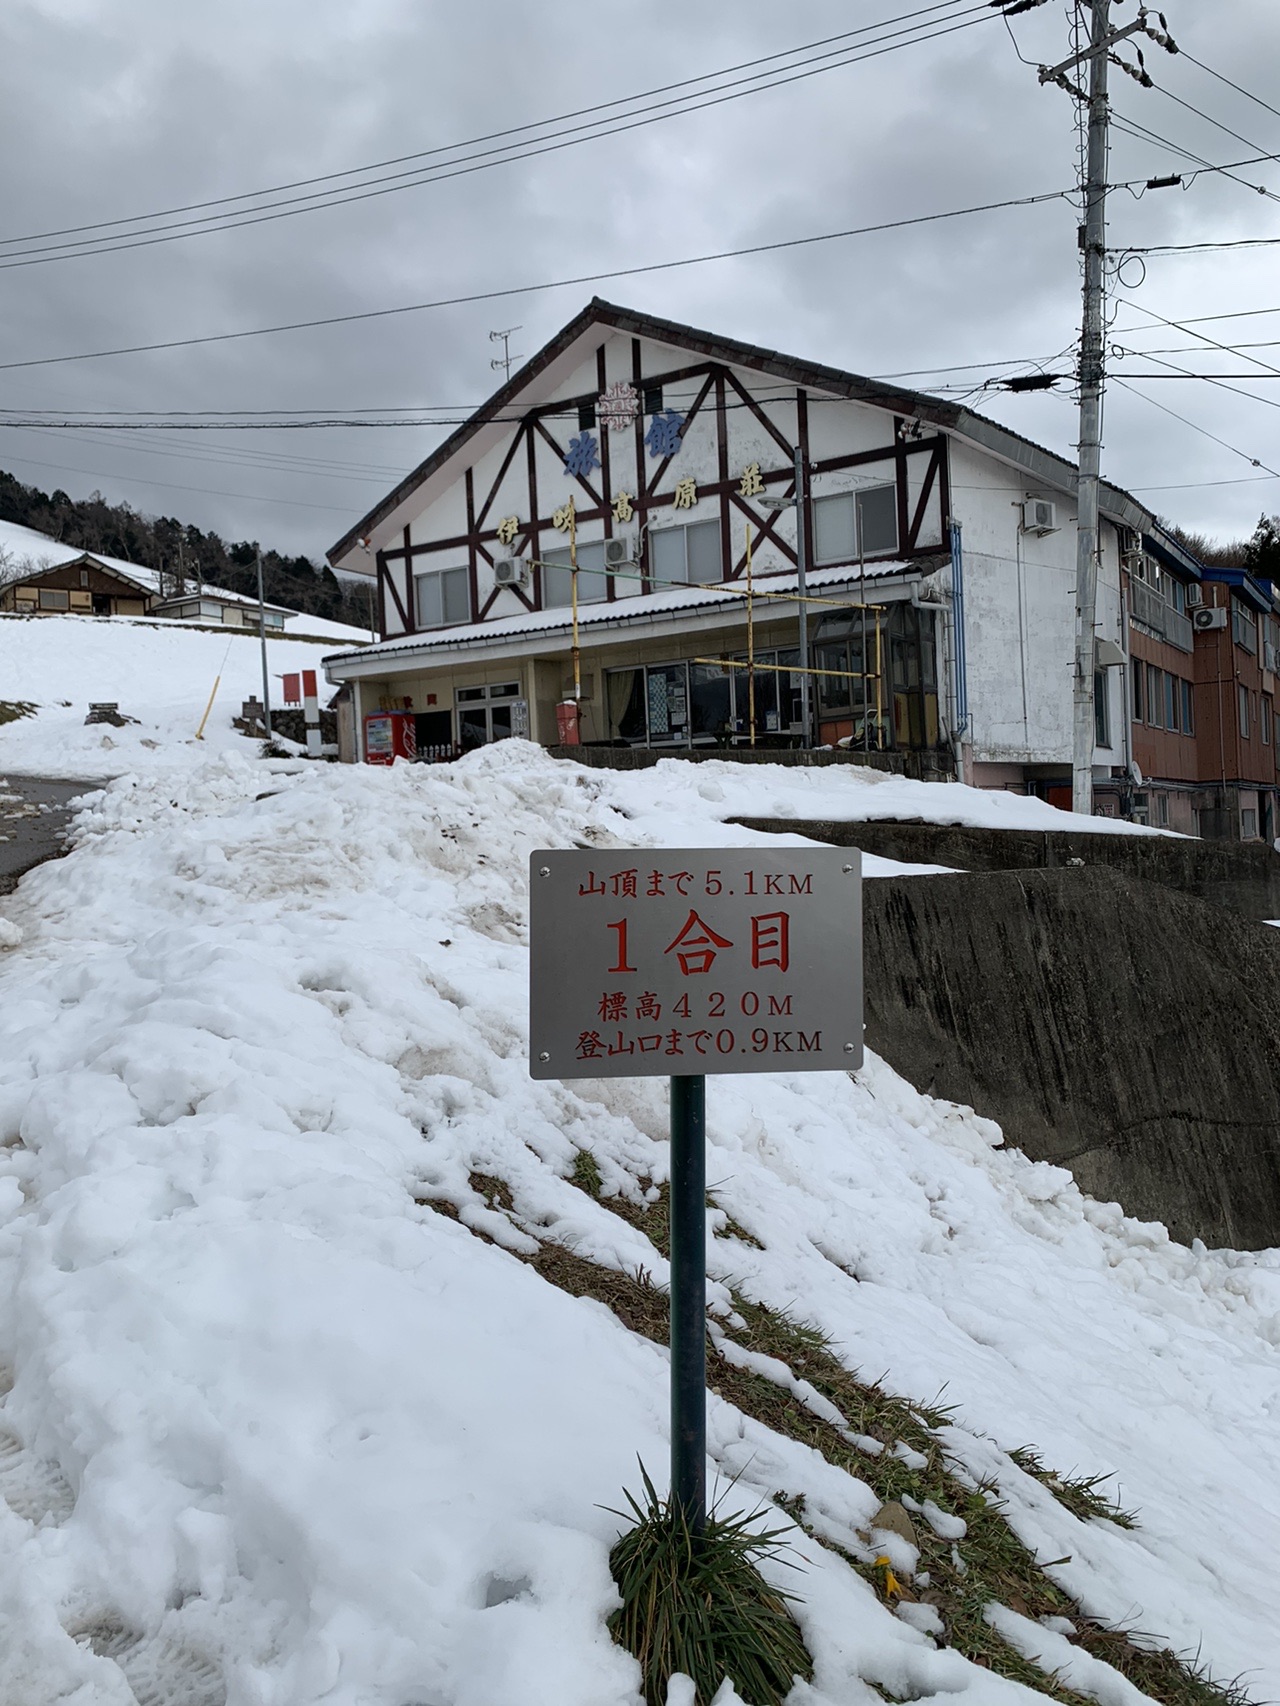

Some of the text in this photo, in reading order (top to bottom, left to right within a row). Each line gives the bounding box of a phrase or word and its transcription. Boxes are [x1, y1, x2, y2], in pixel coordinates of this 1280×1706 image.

[563, 407, 685, 478] 旅館
[606, 908, 790, 977] 1合目
[597, 990, 794, 1023] 標高420M
[575, 1027, 823, 1060] 登山口まで0.9KM
